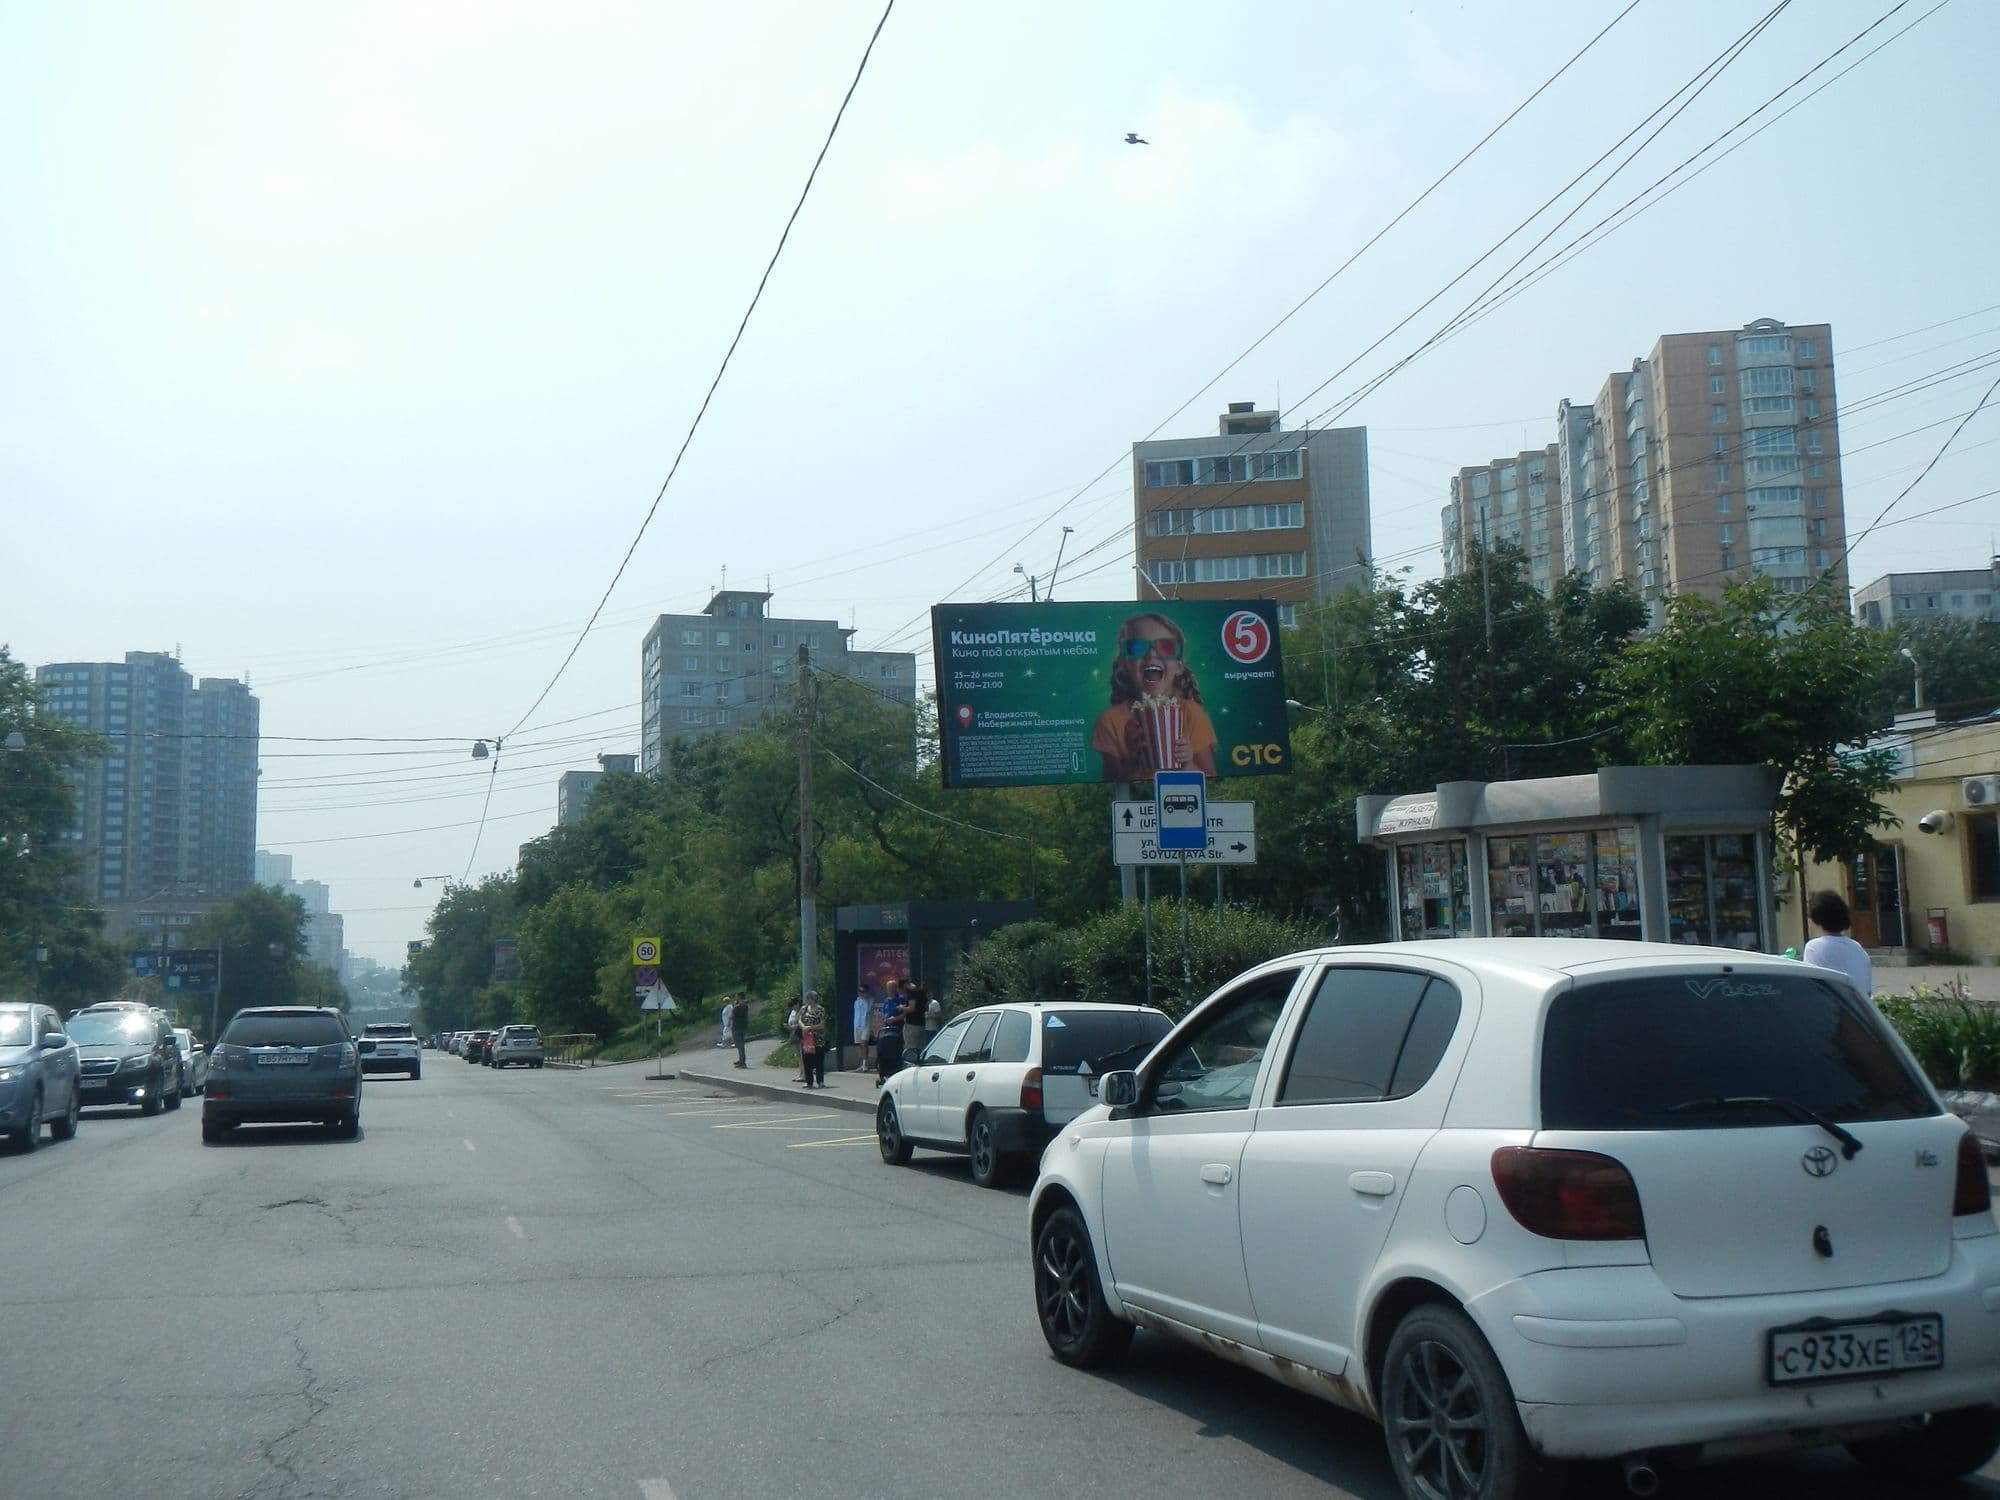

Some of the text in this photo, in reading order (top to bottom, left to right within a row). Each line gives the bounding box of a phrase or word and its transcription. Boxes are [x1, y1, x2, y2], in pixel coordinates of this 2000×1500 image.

[951, 628, 1096, 646] КиноПятёрочка
[1235, 615, 1258, 653] 5
[952, 645, 1098, 658] Кино под открытым небом
[1224, 670, 1275, 681] выручает!
[978, 718, 1085, 729] Набережная Цесаревича
[1231, 743, 1283, 766] СТС
[1208, 850, 1225, 860] Str.
[641, 946, 653, 956] 50
[875, 949, 910, 959] АПТЕК
[1783, 1324, 1934, 1373] С933ХЕ 125
